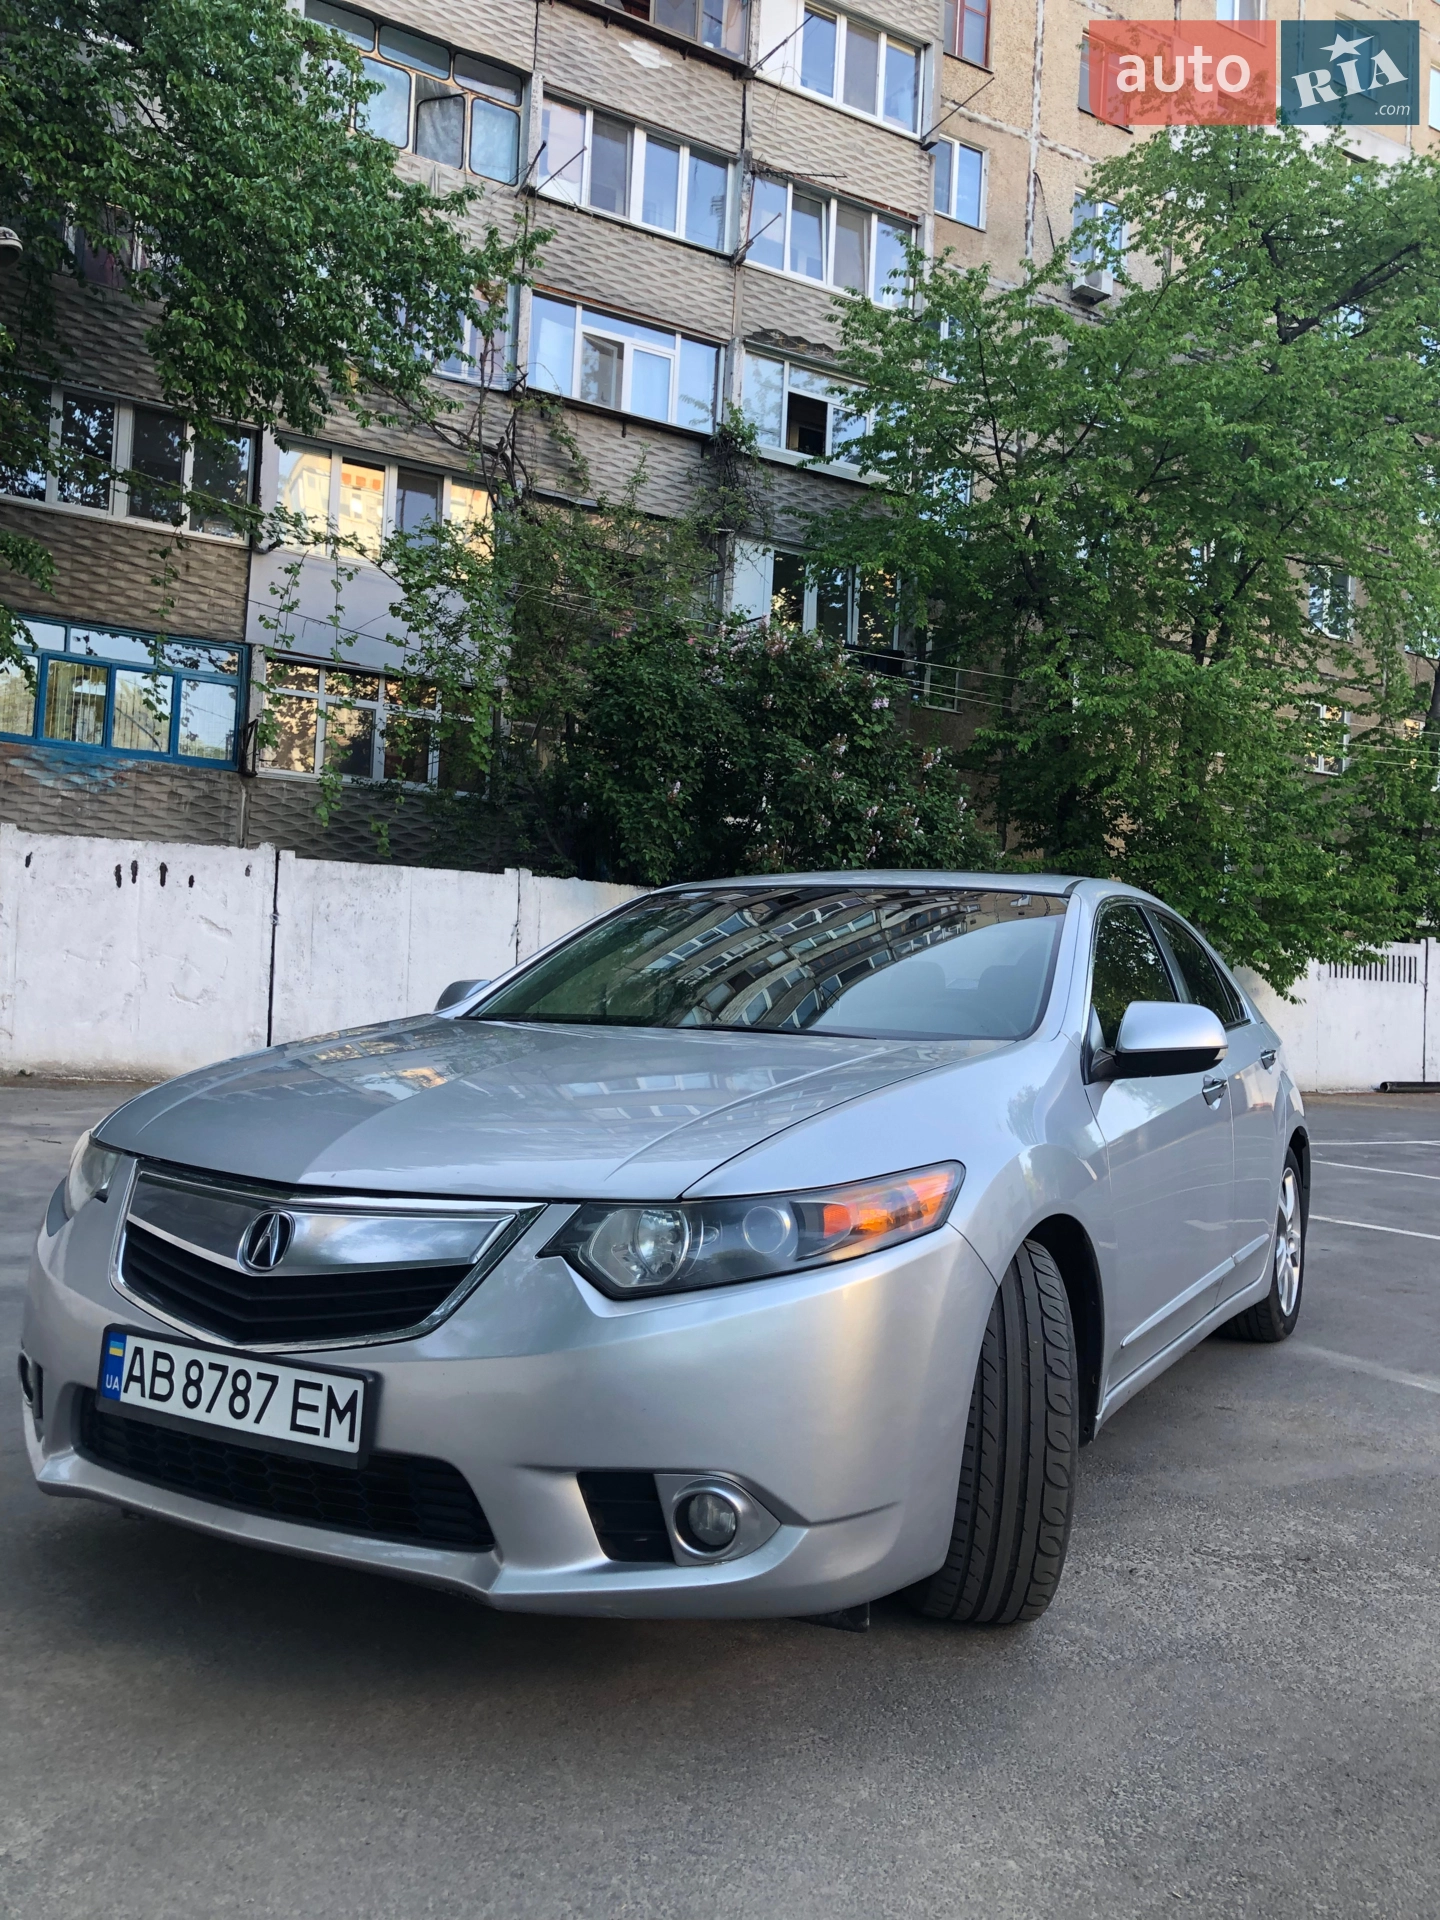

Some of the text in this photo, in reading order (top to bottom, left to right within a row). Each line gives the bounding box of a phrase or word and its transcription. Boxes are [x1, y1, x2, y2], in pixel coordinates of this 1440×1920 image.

[106, 1373, 120, 1391] UA
[123, 1346, 359, 1443] AB 8787 EM
